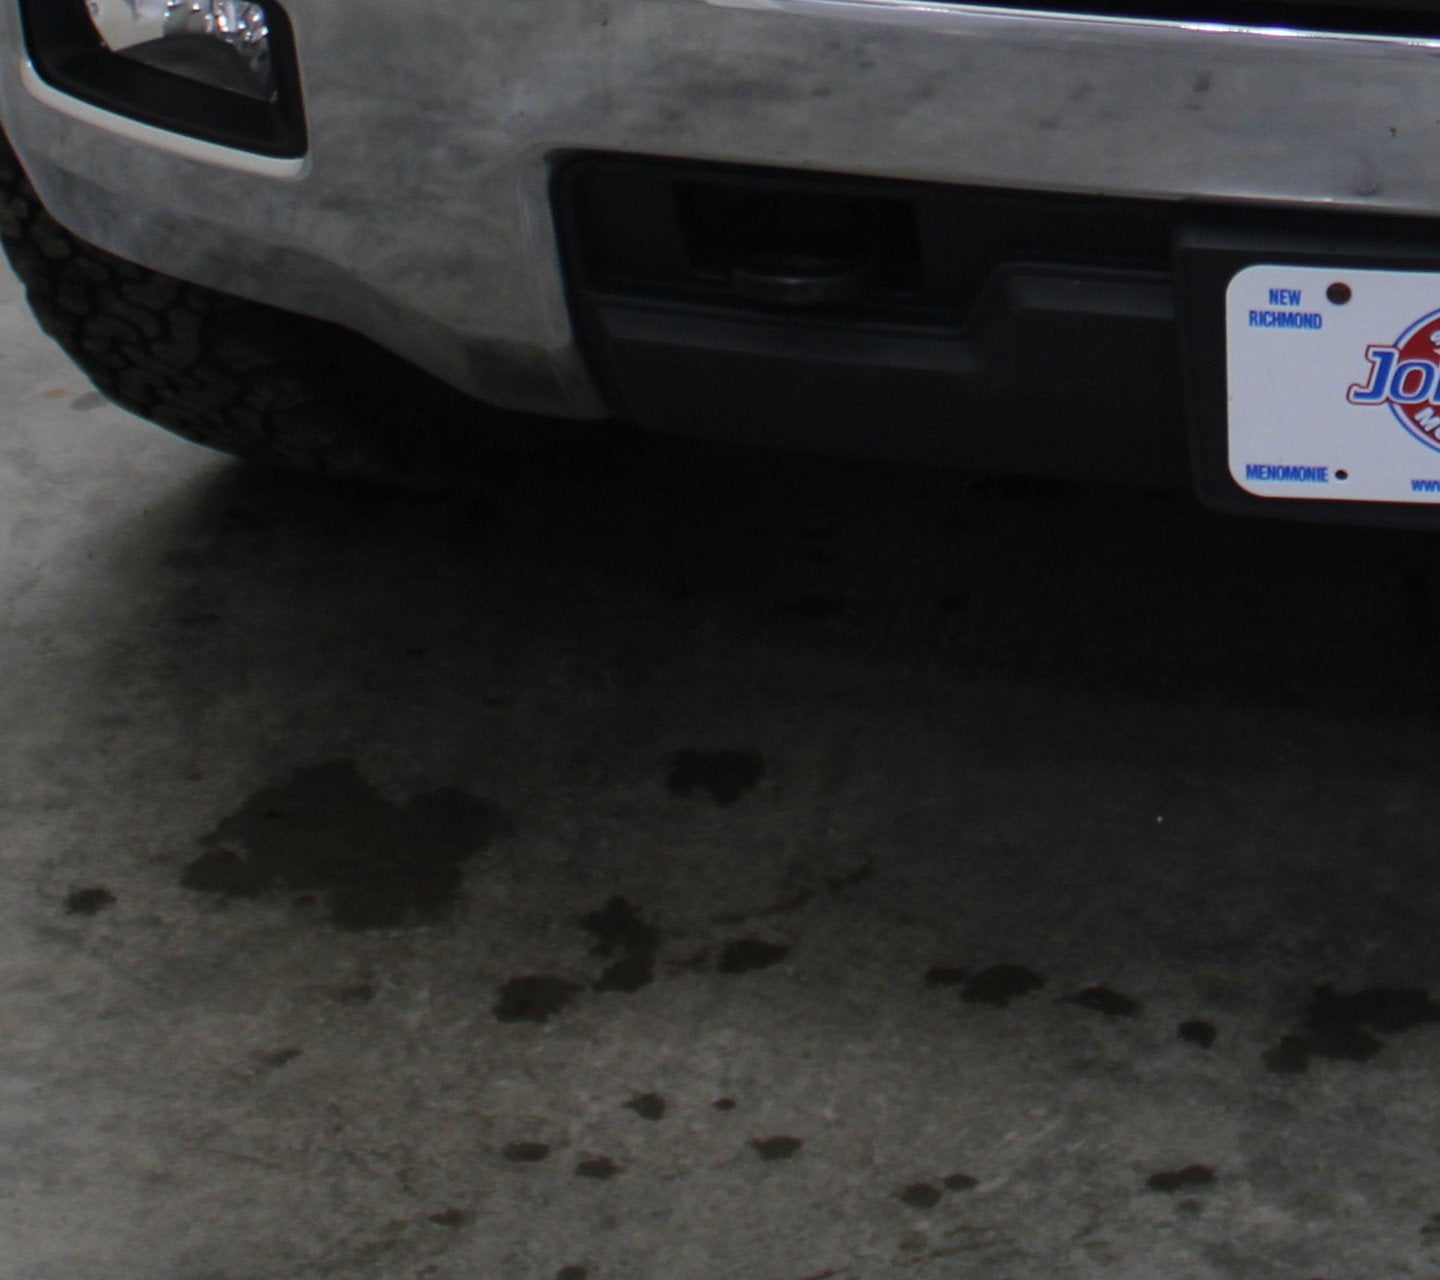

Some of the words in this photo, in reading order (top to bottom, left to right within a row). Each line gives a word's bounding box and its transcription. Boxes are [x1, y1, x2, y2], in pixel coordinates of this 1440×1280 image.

[1268, 288, 1302, 307] NEW
[1248, 310, 1323, 330] RICHMOND
[1245, 463, 1329, 482] MENOMONIE
